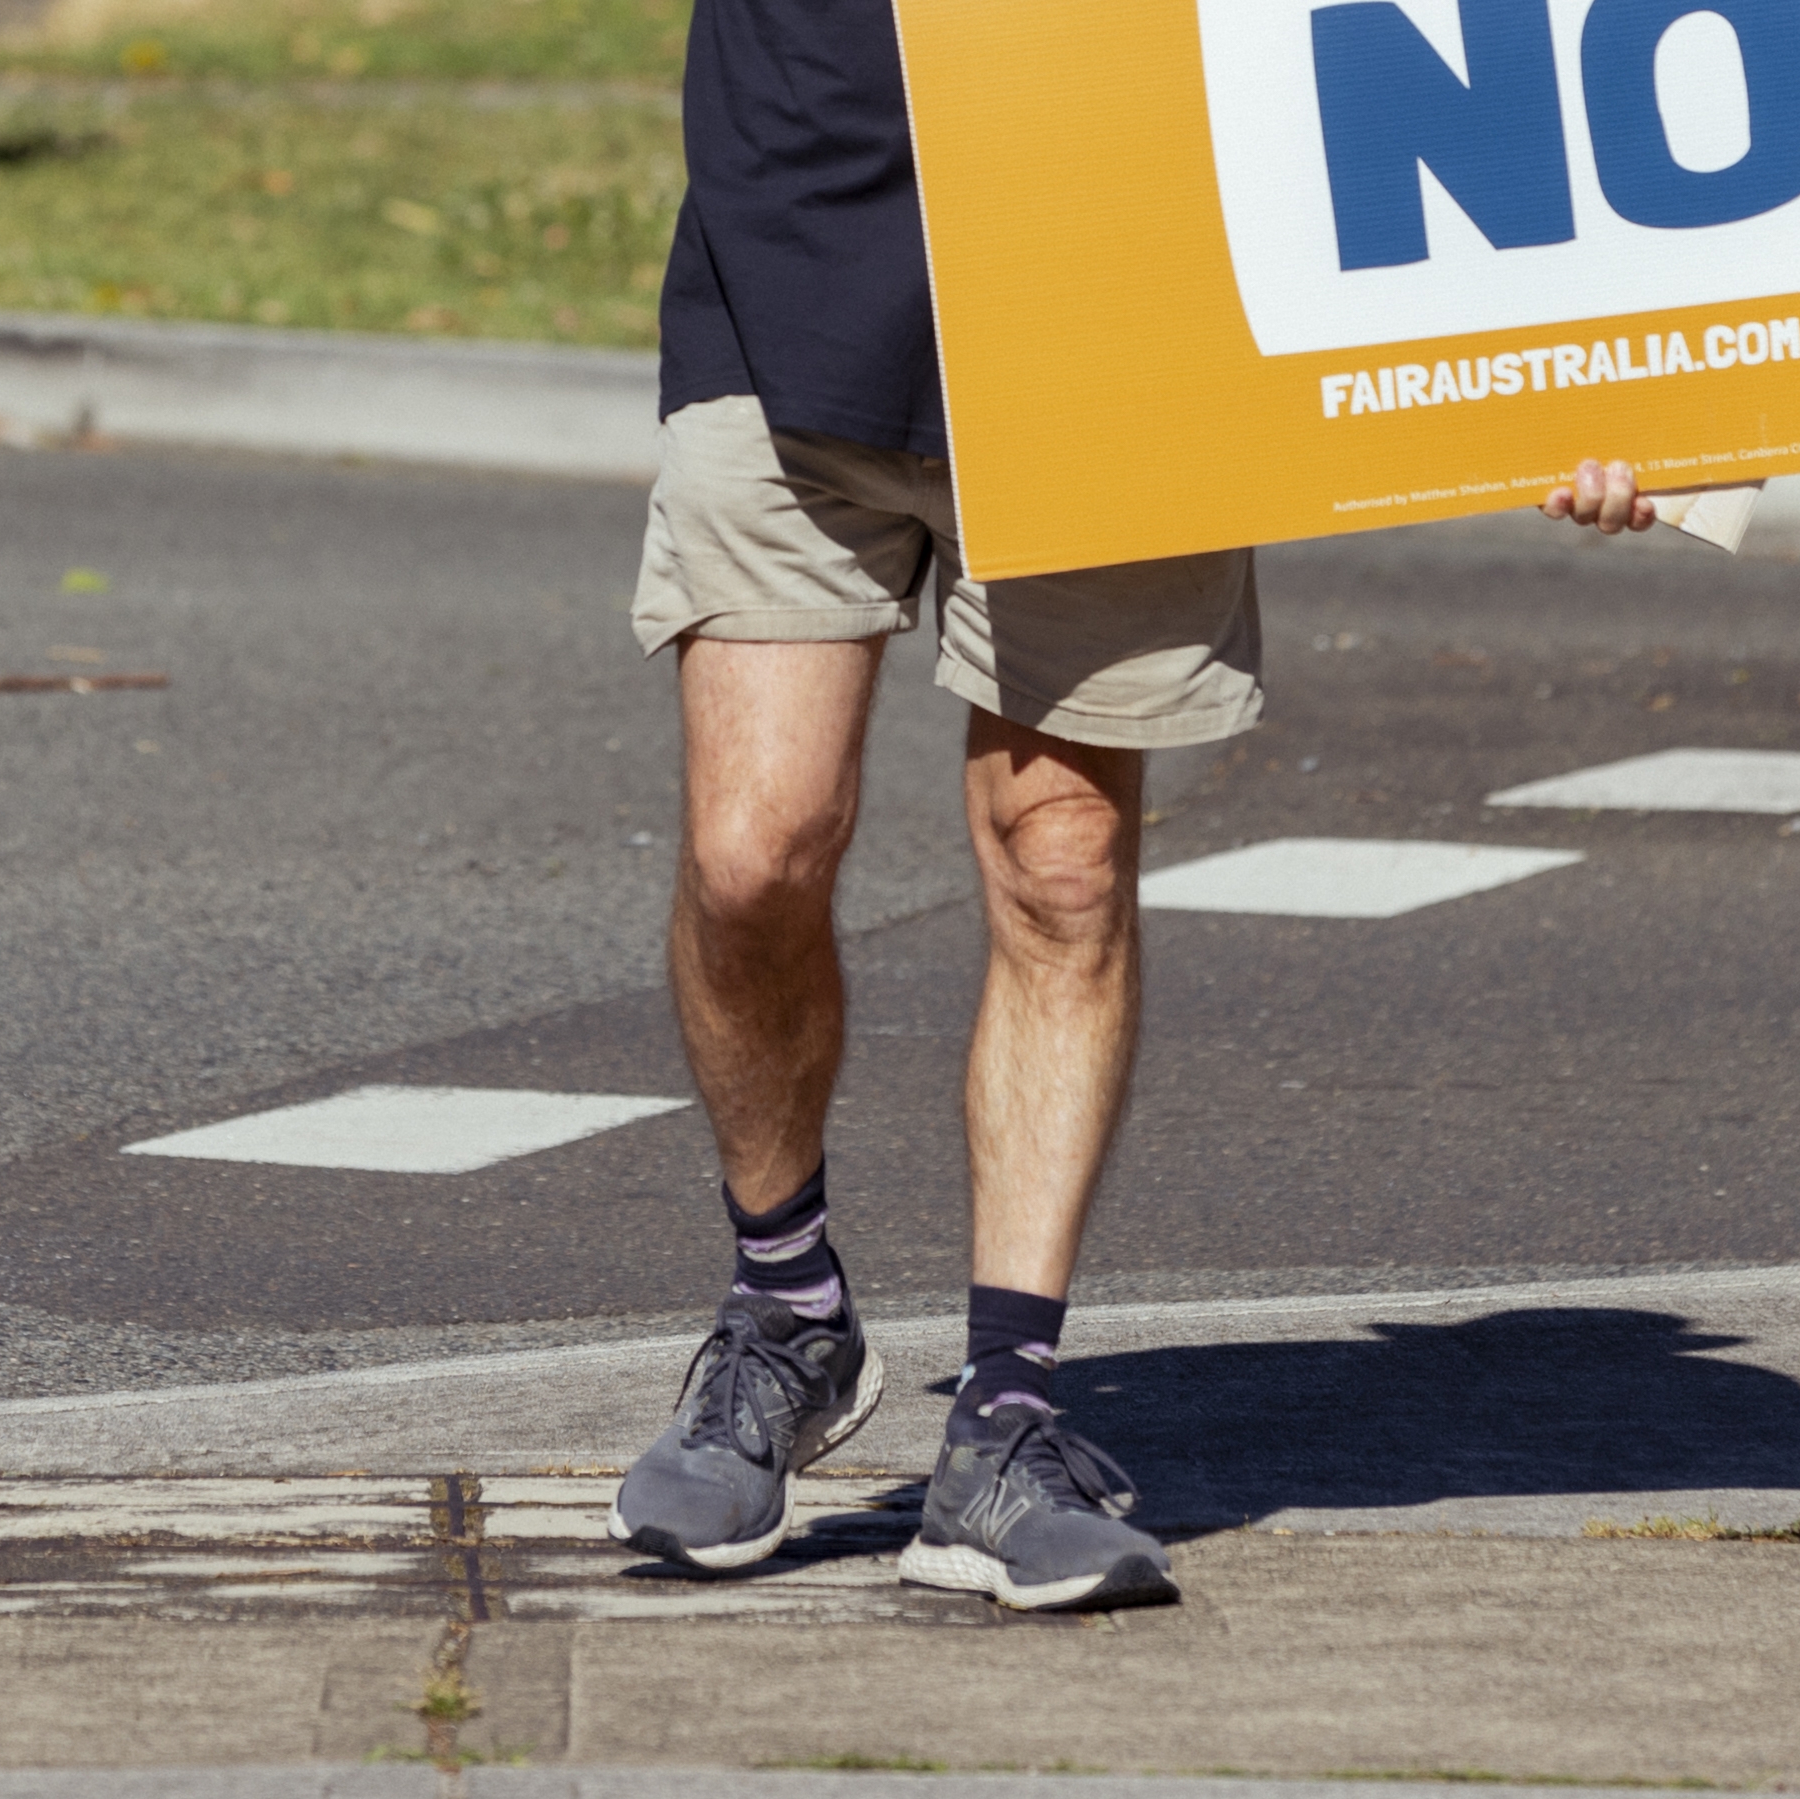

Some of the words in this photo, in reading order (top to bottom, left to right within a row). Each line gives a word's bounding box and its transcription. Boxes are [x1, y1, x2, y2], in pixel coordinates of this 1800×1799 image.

[1395, 493, 1408, 507] by
[1410, 486, 1457, 502] Matthew
[1510, 472, 1556, 489] Advance
[1738, 444, 1789, 461] Canberra
